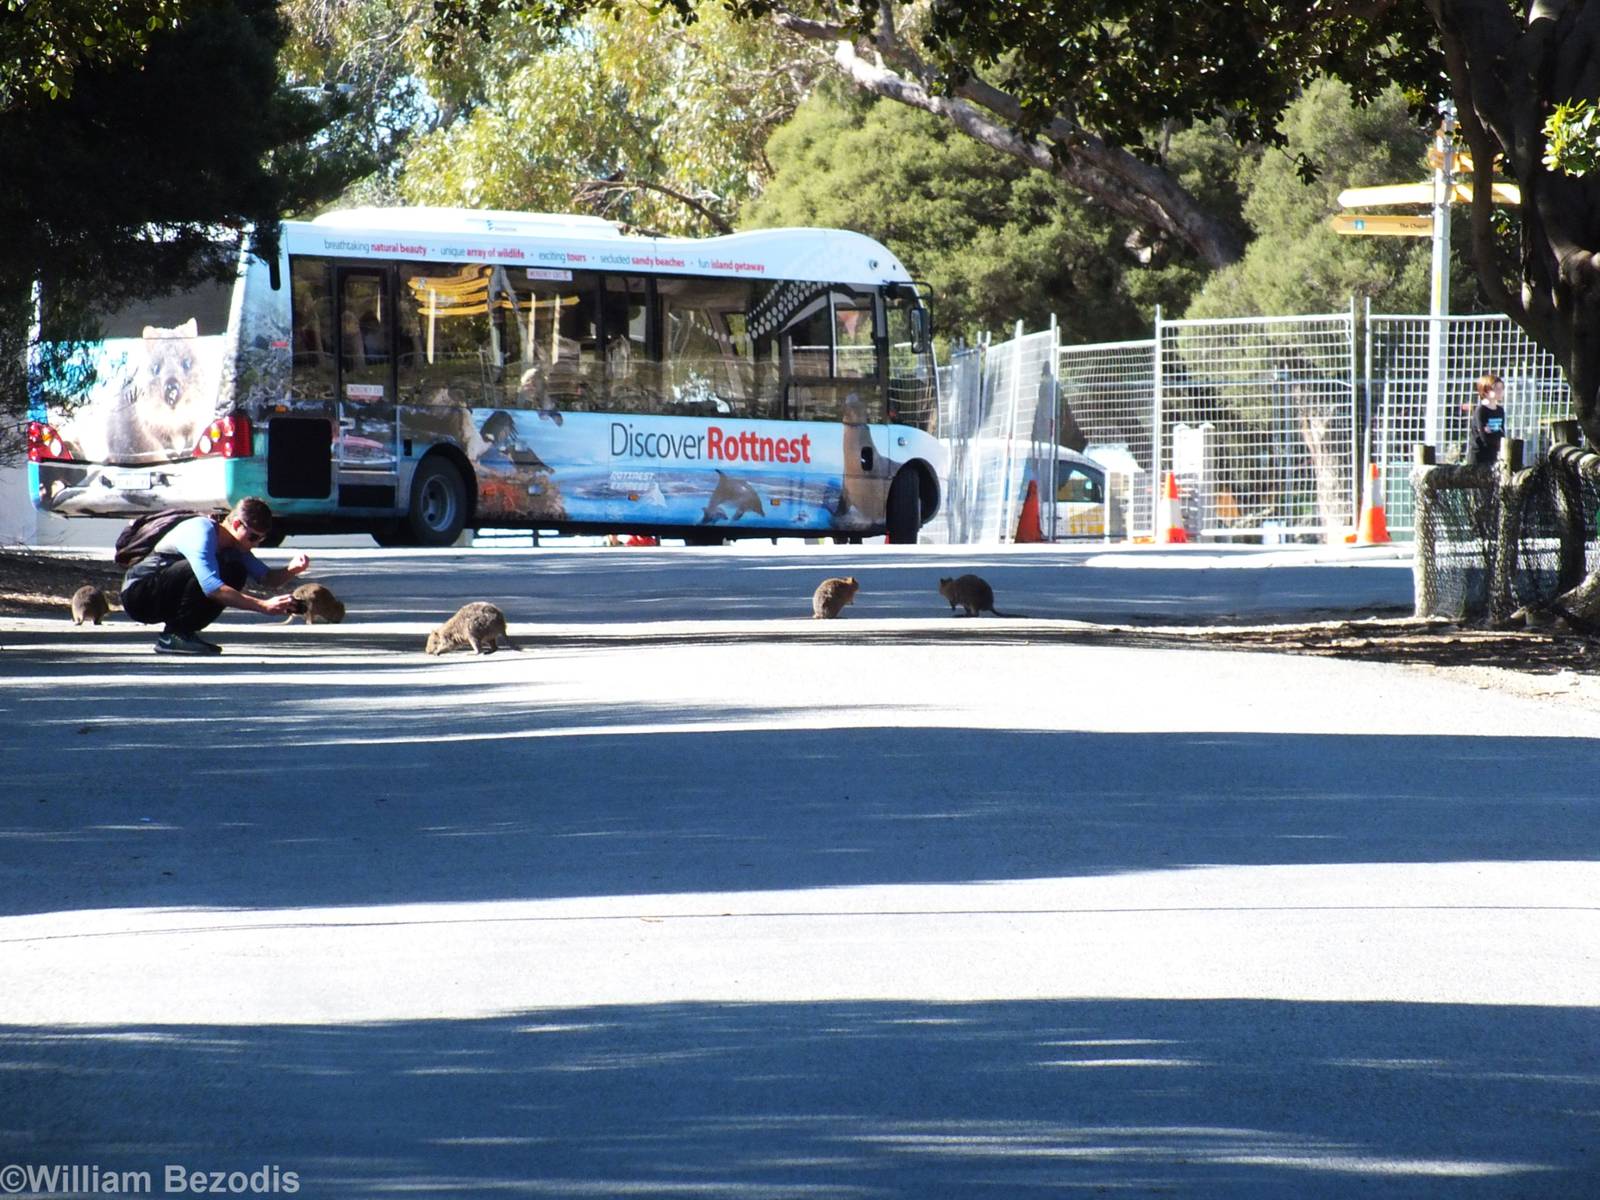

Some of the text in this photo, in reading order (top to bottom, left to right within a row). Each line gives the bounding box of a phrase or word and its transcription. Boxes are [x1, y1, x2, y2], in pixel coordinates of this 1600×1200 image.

[324, 239, 370, 254] breathtaking
[371, 243, 398, 253] natural
[400, 243, 427, 256] beauty
[440, 247, 465, 258] unique
[466, 247, 486, 259] array
[487, 248, 496, 257] of
[497, 248, 525, 259] wildlife
[538, 252, 566, 264] exciting
[567, 253, 587, 262] tours
[631, 256, 653, 268] sandy
[655, 257, 685, 268] beaches
[698, 259, 709, 269] fun
[711, 260, 733, 270] island
[734, 261, 765, 274] getaway
[610, 422, 811, 464] Discover Rottnest
